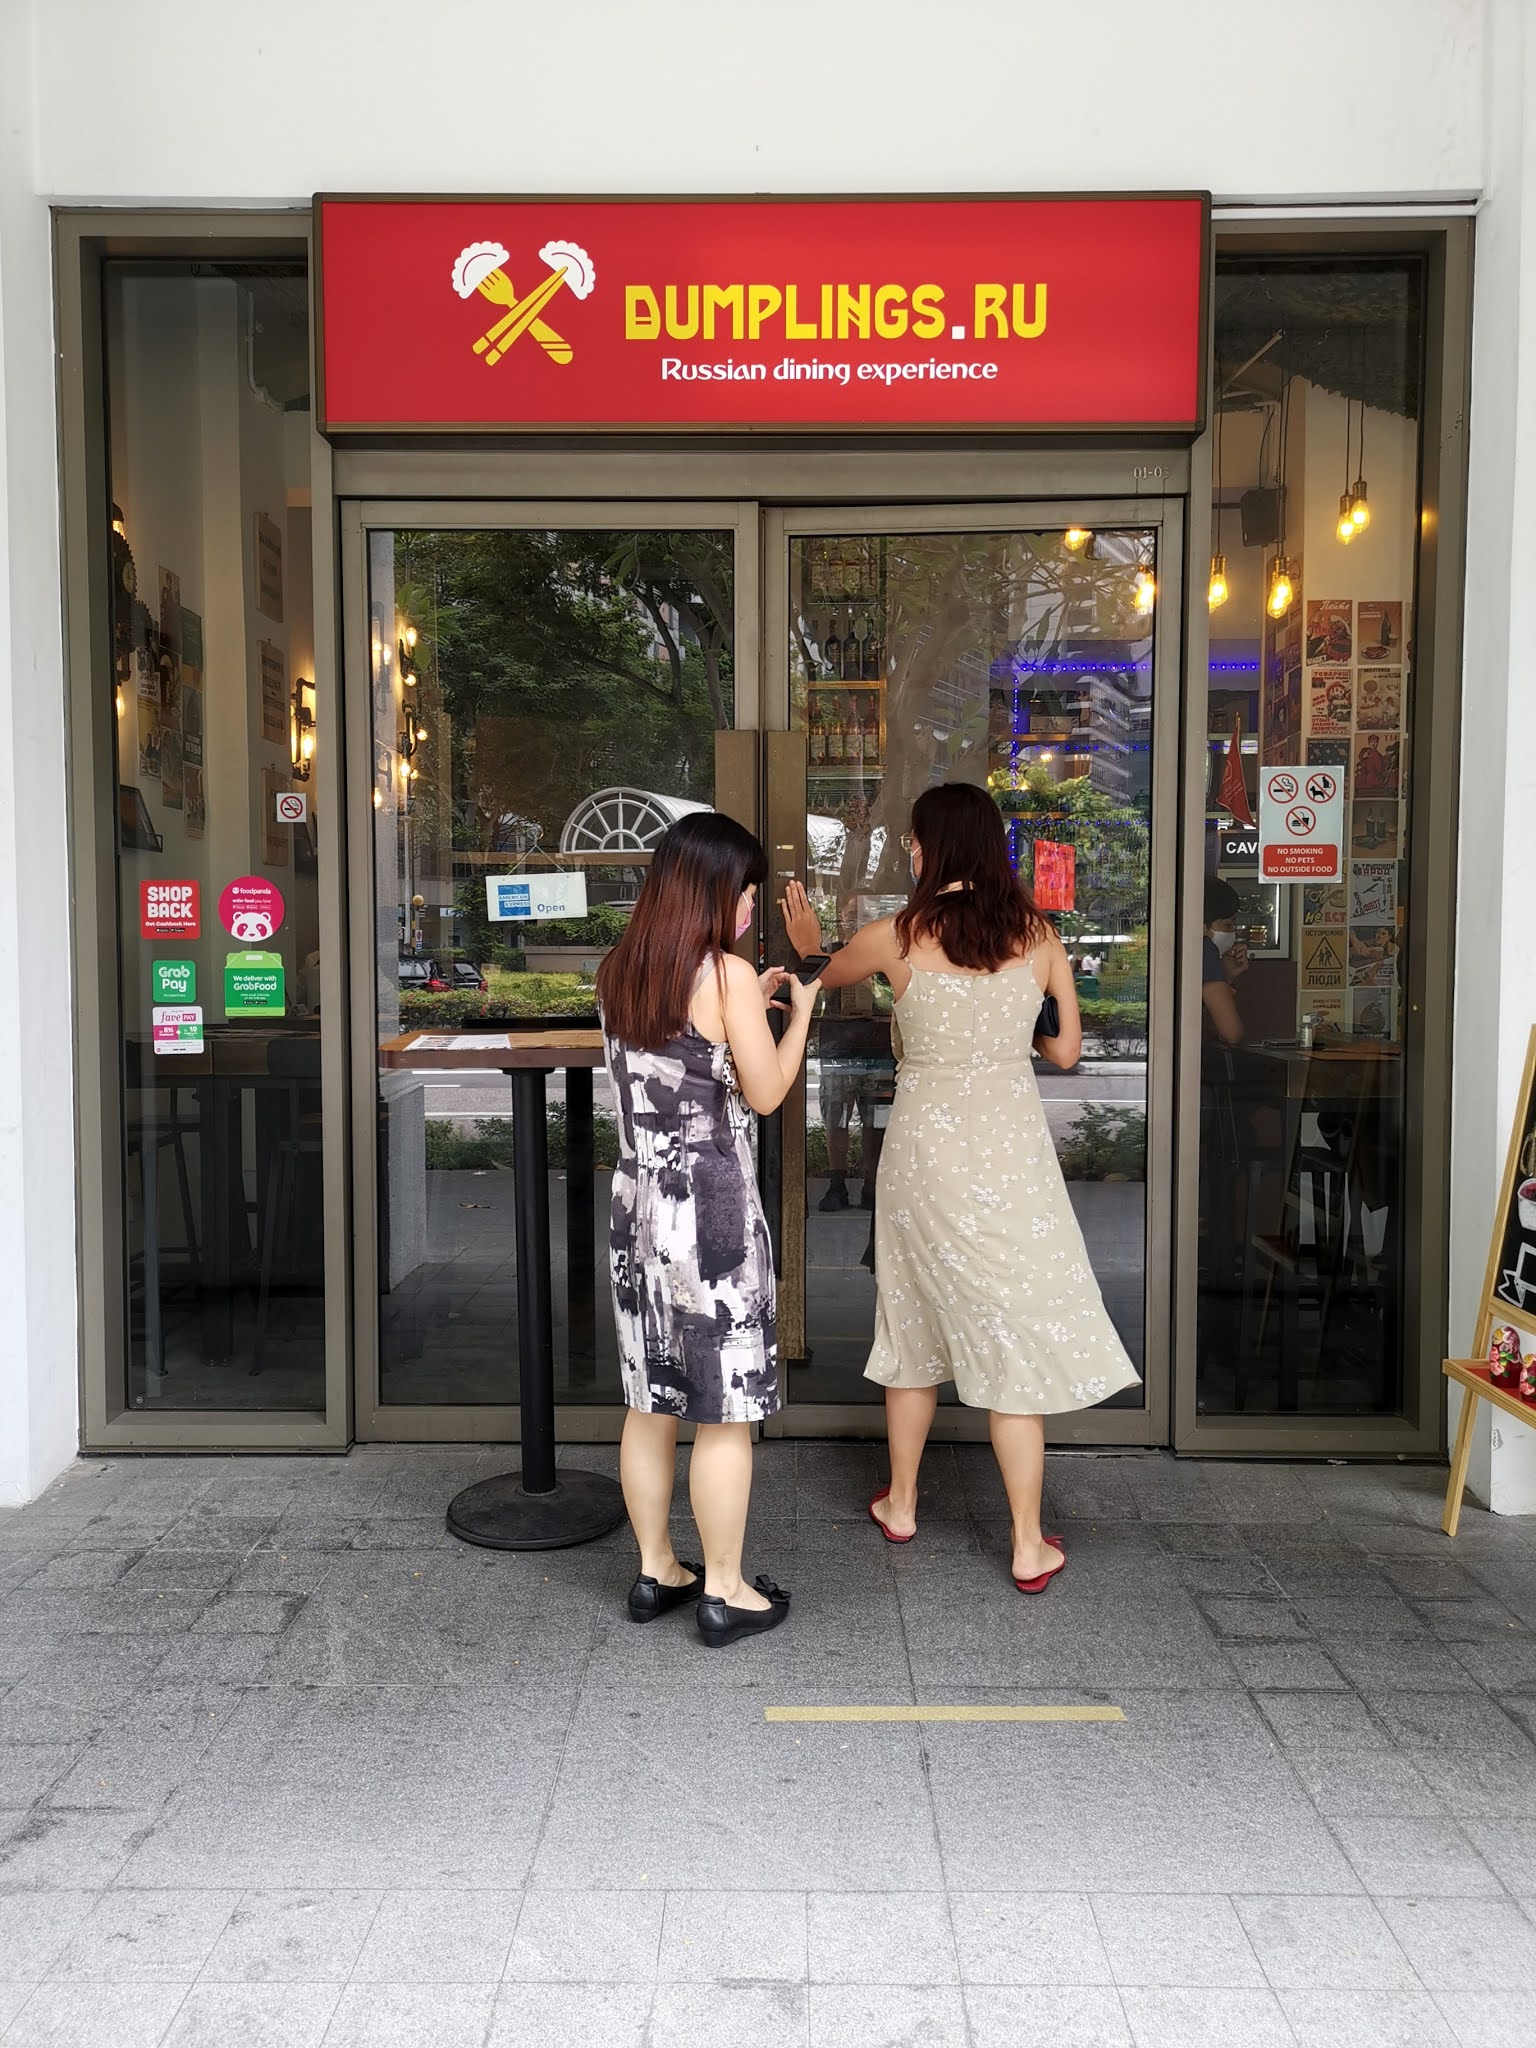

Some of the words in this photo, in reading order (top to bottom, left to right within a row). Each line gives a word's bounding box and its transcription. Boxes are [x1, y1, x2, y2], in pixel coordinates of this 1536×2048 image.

[625, 283, 1048, 340] DUMPLINGS.RU
[661, 357, 767, 381] Russian
[772, 357, 851, 386] dining
[855, 357, 999, 386] experience
[147, 886, 193, 902] SHOP
[240, 887, 272, 895] foodpanda
[147, 902, 193, 918] BACK
[537, 903, 566, 914] Open
[158, 965, 190, 978] Grab
[162, 978, 187, 993] Pay
[233, 982, 277, 991] GrabFood
[1307, 974, 1341, 986] ЛЮДИ
[160, 1011, 181, 1024] fave
